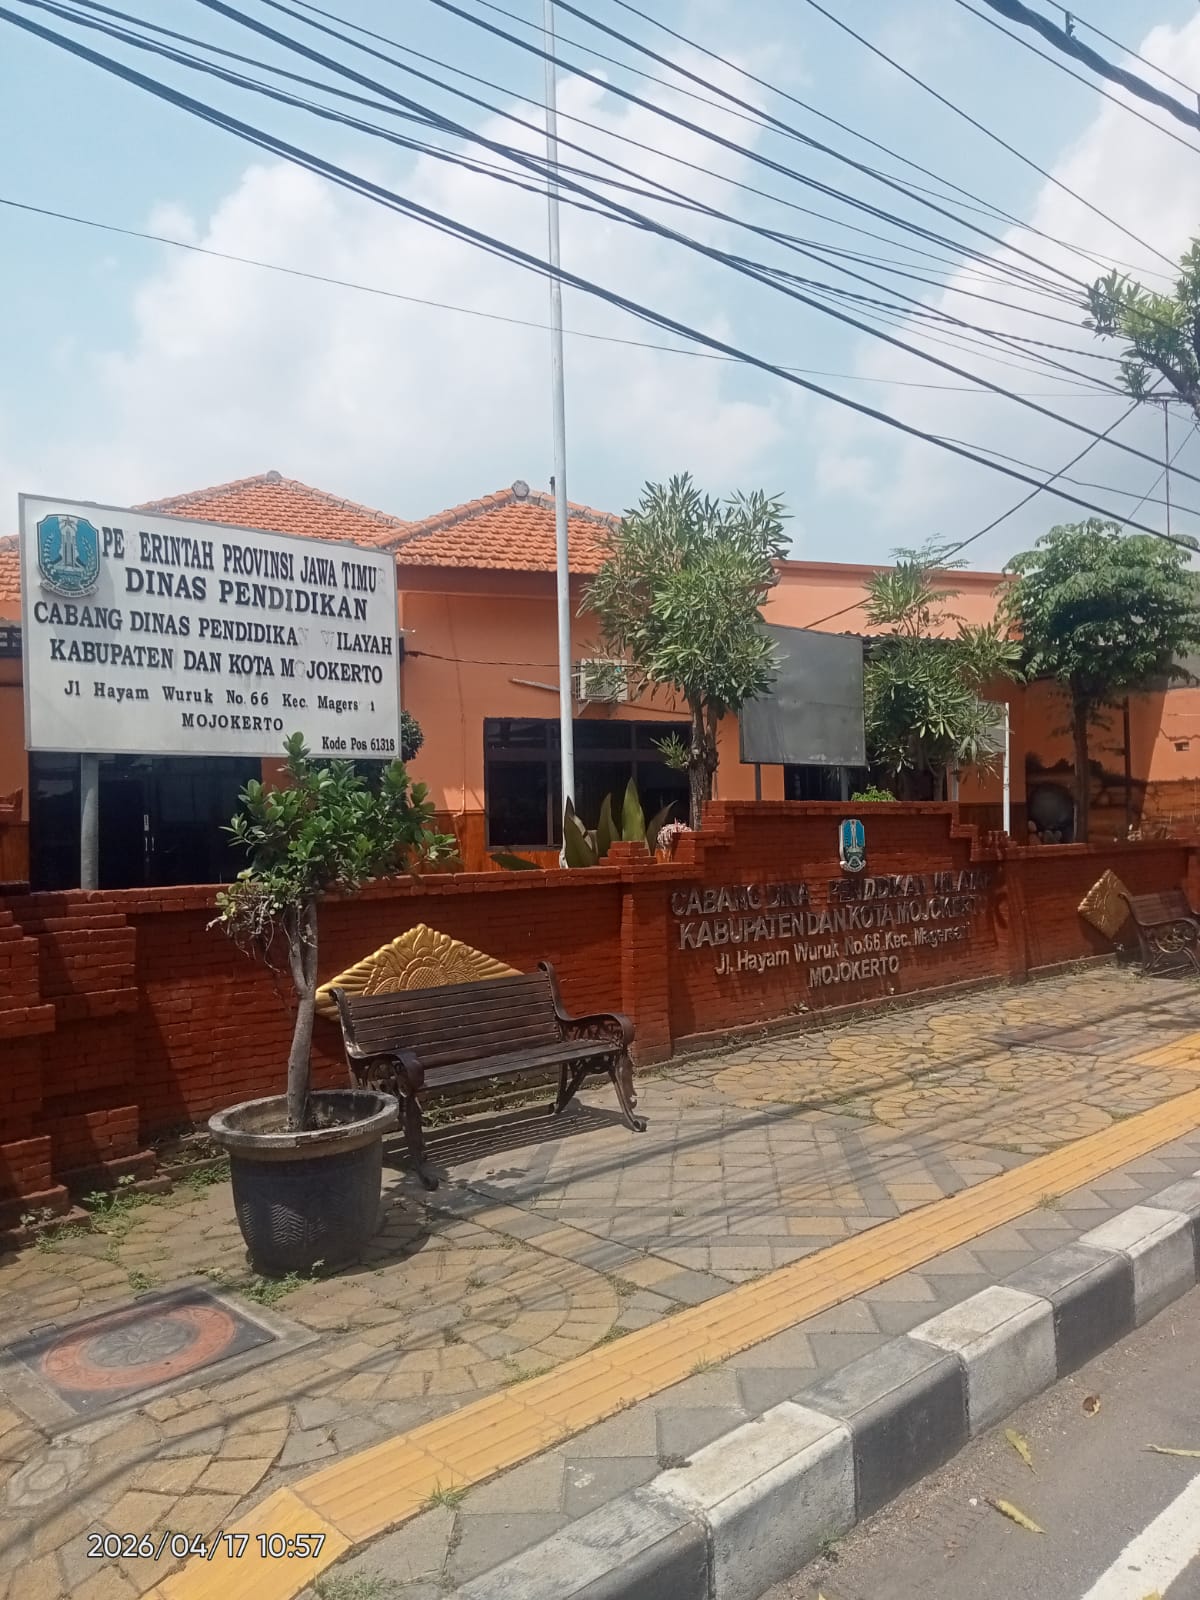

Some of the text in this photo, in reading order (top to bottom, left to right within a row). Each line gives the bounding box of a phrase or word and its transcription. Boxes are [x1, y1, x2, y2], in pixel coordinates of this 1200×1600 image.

[102, 527, 385, 593] PEERINTAH PROVINSI JAWA TIMU
[125, 567, 207, 601] DINAS
[219, 579, 368, 621] PENDIDIKAN
[34, 601, 122, 631] CABANG
[130, 611, 190, 636] DINAS
[198, 617, 308, 647] PENDIDIKA
[50, 638, 383, 684] KABUPATEN DAN KOTA MJOKERTO
[65, 680, 80, 696] Jl
[94, 682, 149, 703] Hayam
[162, 685, 214, 704] Wuruk
[282, 693, 308, 709] Kec.
[182, 712, 284, 732] MOJOKERTO
[322, 736, 395, 752] Kode Pos 61318
[678, 911, 804, 950] KABUPATEN
[807, 906, 845, 936] DAN
[846, 903, 895, 930] KOTA
[737, 949, 790, 974] Hayam
[793, 938, 839, 964] Wuruk
[808, 955, 899, 987] MOJOKERTO
